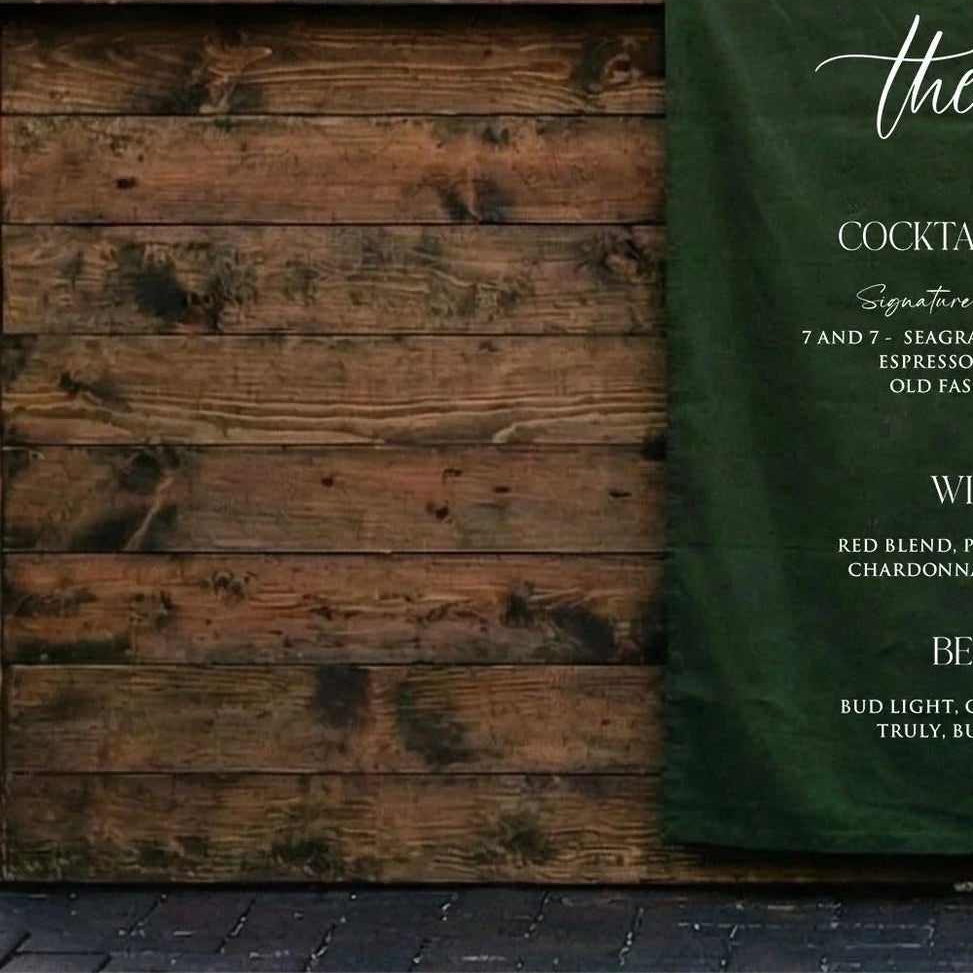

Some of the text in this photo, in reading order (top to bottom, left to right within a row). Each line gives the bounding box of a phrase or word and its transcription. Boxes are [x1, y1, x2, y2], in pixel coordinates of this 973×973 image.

[801, 329, 813, 345] 7
[816, 329, 863, 345] AND
[869, 329, 880, 345] 7
[879, 353, 973, 370] ESPRESSO
[889, 378, 932, 394] OLD
[838, 537, 879, 553] RED
[885, 537, 957, 555] BLEND,
[840, 698, 884, 715] BUD
[890, 698, 959, 716] LIGHT,
[876, 723, 946, 740] TRULY,
